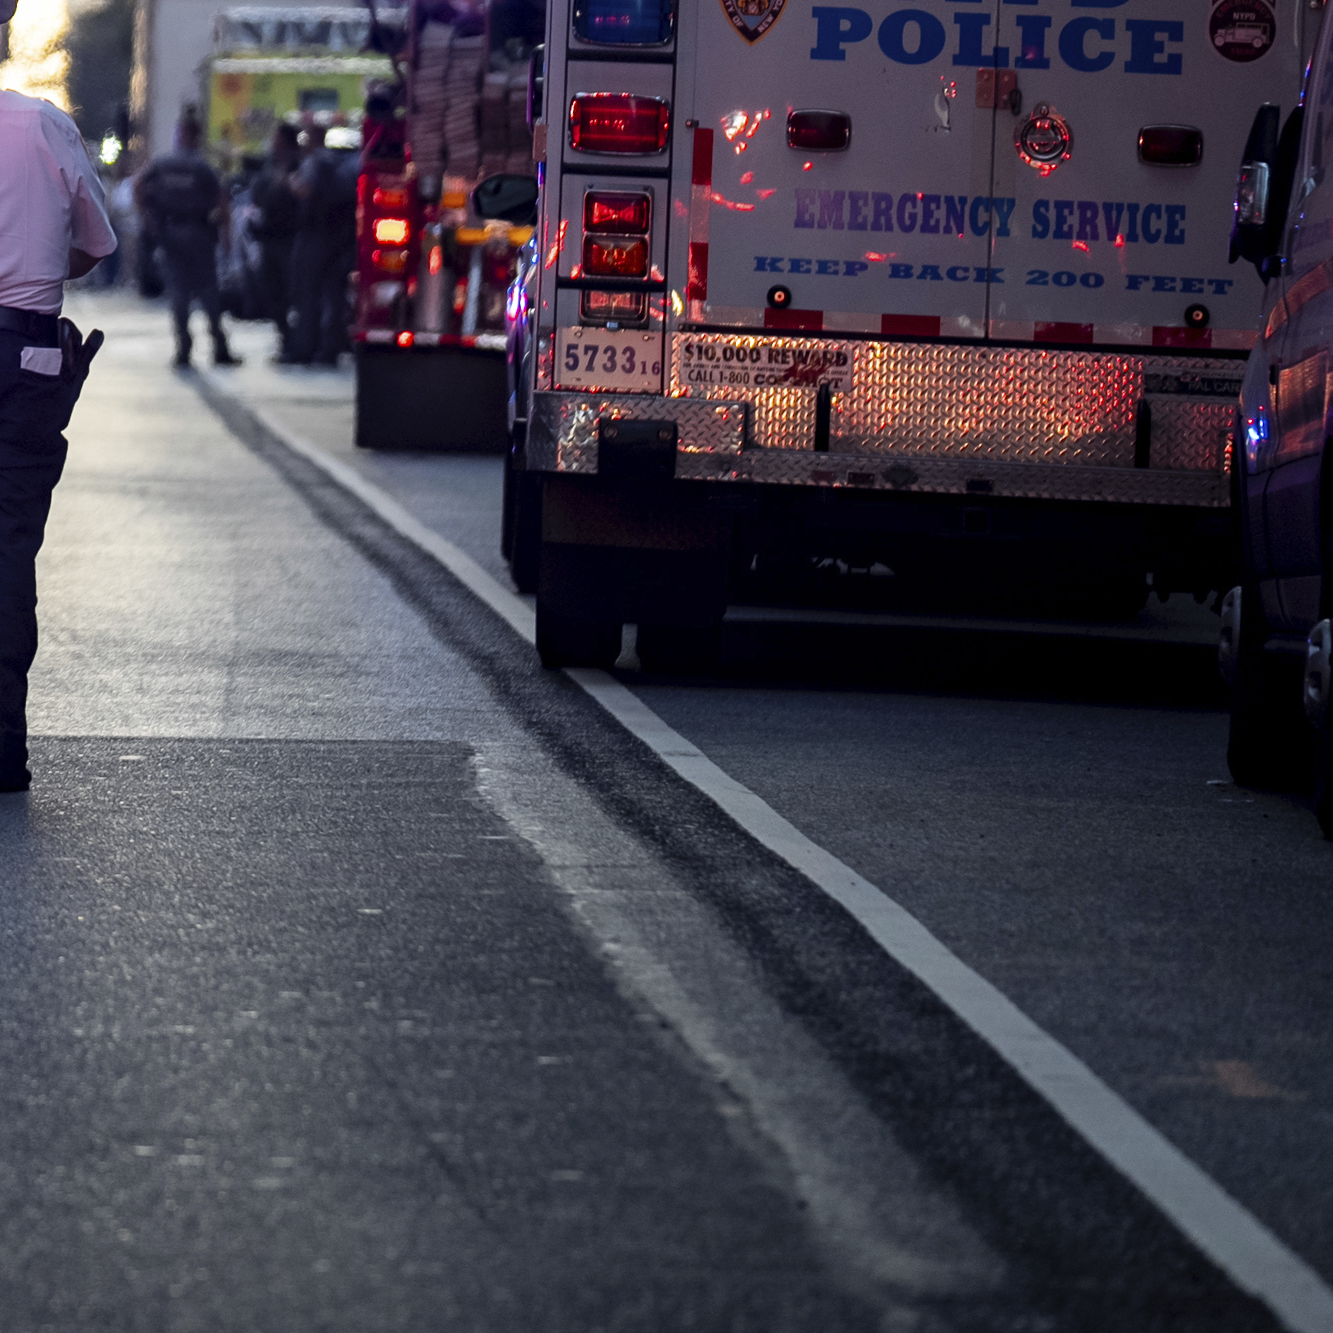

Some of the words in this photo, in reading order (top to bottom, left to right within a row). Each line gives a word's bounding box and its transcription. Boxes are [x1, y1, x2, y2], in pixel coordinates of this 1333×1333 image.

[732, 15, 744, 27] OF
[757, 13, 774, 33] NEW
[1233, 12, 1256, 21] NYPD
[810, 6, 1184, 75] POLICE
[793, 188, 1016, 237] EMERGENCY
[1032, 198, 1186, 245] SERVICE
[753, 256, 869, 277] KEEP
[888, 263, 1005, 284] BACK
[1025, 269, 1105, 288] 200
[1125, 274, 1233, 295] FEET
[564, 343, 636, 374] 5733
[640, 360, 661, 376] 16
[684, 342, 761, 364] $10,000
[767, 348, 848, 367] REWARD
[688, 369, 715, 384] CALL
[719, 371, 750, 386] 1-800
